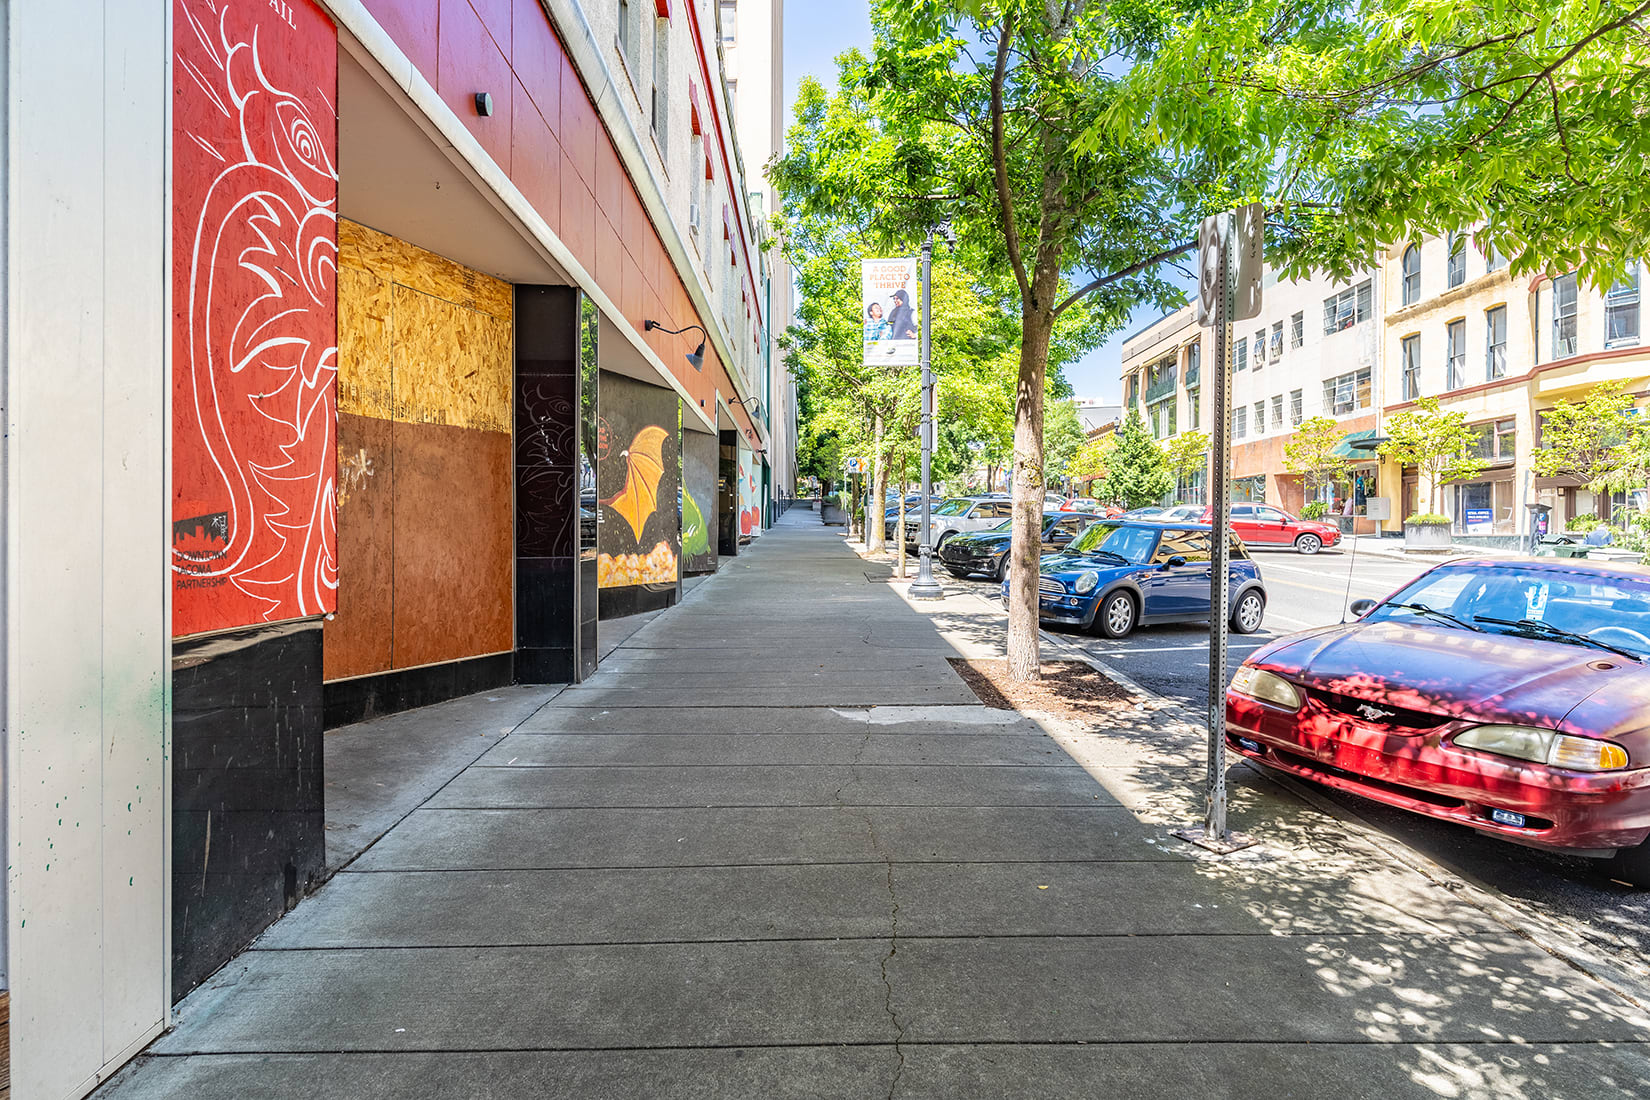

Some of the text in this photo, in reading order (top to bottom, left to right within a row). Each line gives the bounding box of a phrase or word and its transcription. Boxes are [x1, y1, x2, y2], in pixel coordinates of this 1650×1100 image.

[870, 273, 911, 281] PLACE TO
[873, 281, 906, 289] THRIVE
[176, 550, 228, 562] DOWNTOWN
[176, 564, 212, 576] TACOMA
[176, 577, 228, 590] PARTNERSHIP
